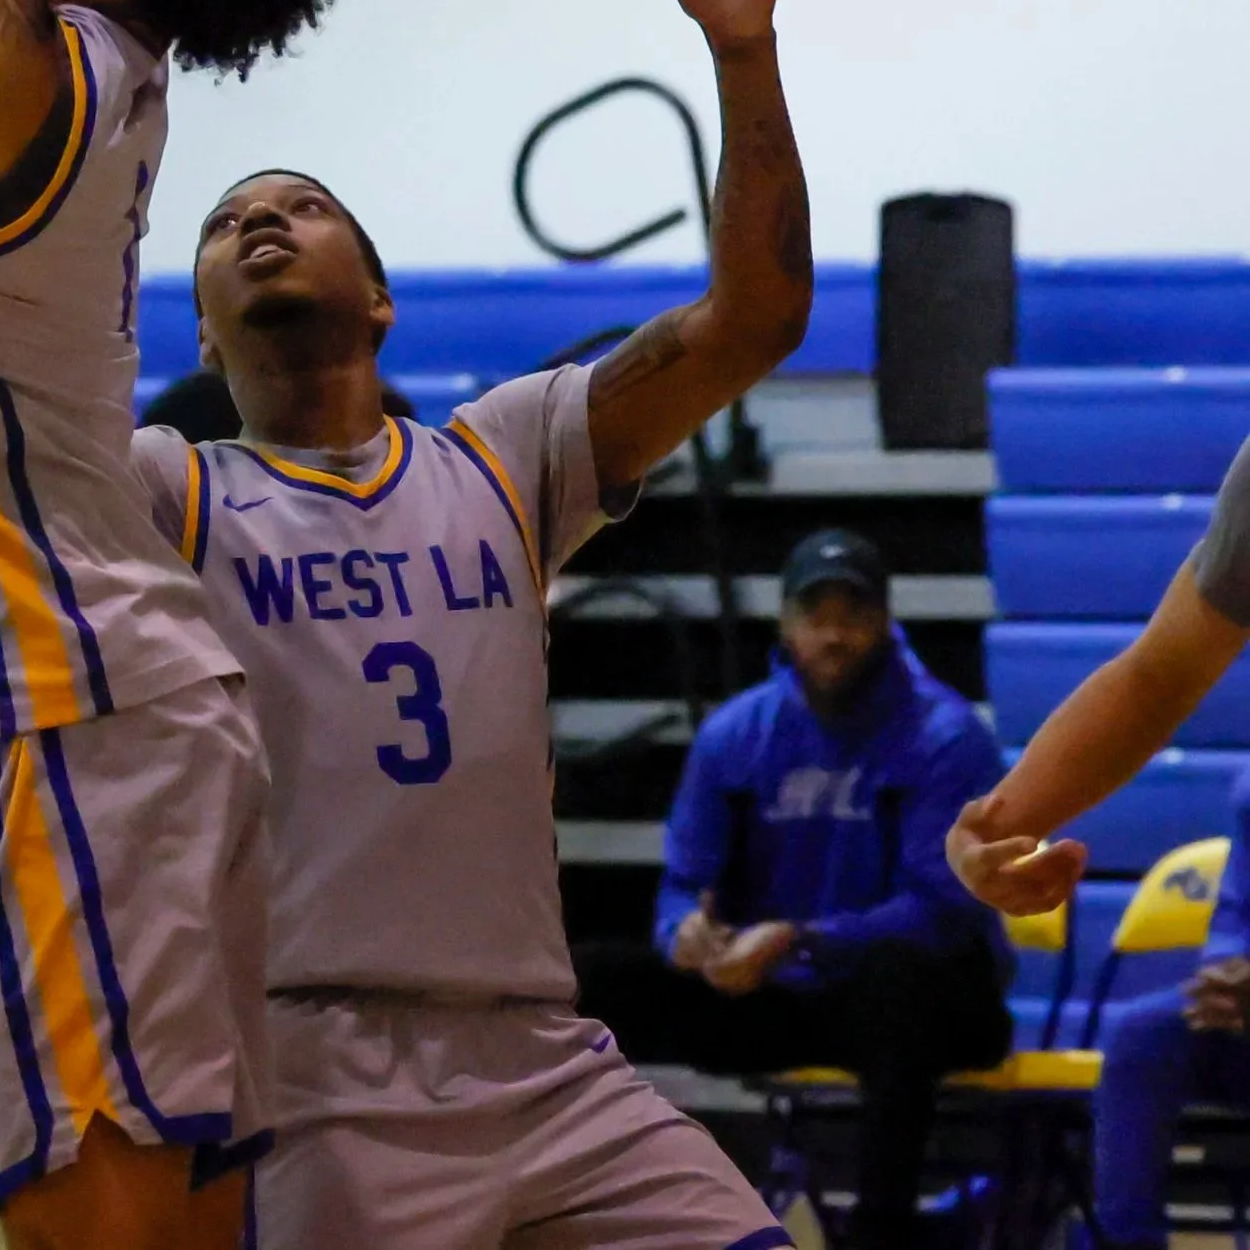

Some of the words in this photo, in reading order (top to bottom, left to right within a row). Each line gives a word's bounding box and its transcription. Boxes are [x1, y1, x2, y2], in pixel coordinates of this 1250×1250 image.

[232, 552, 414, 626] WEST
[429, 539, 514, 611] LA
[362, 640, 452, 786] 3
